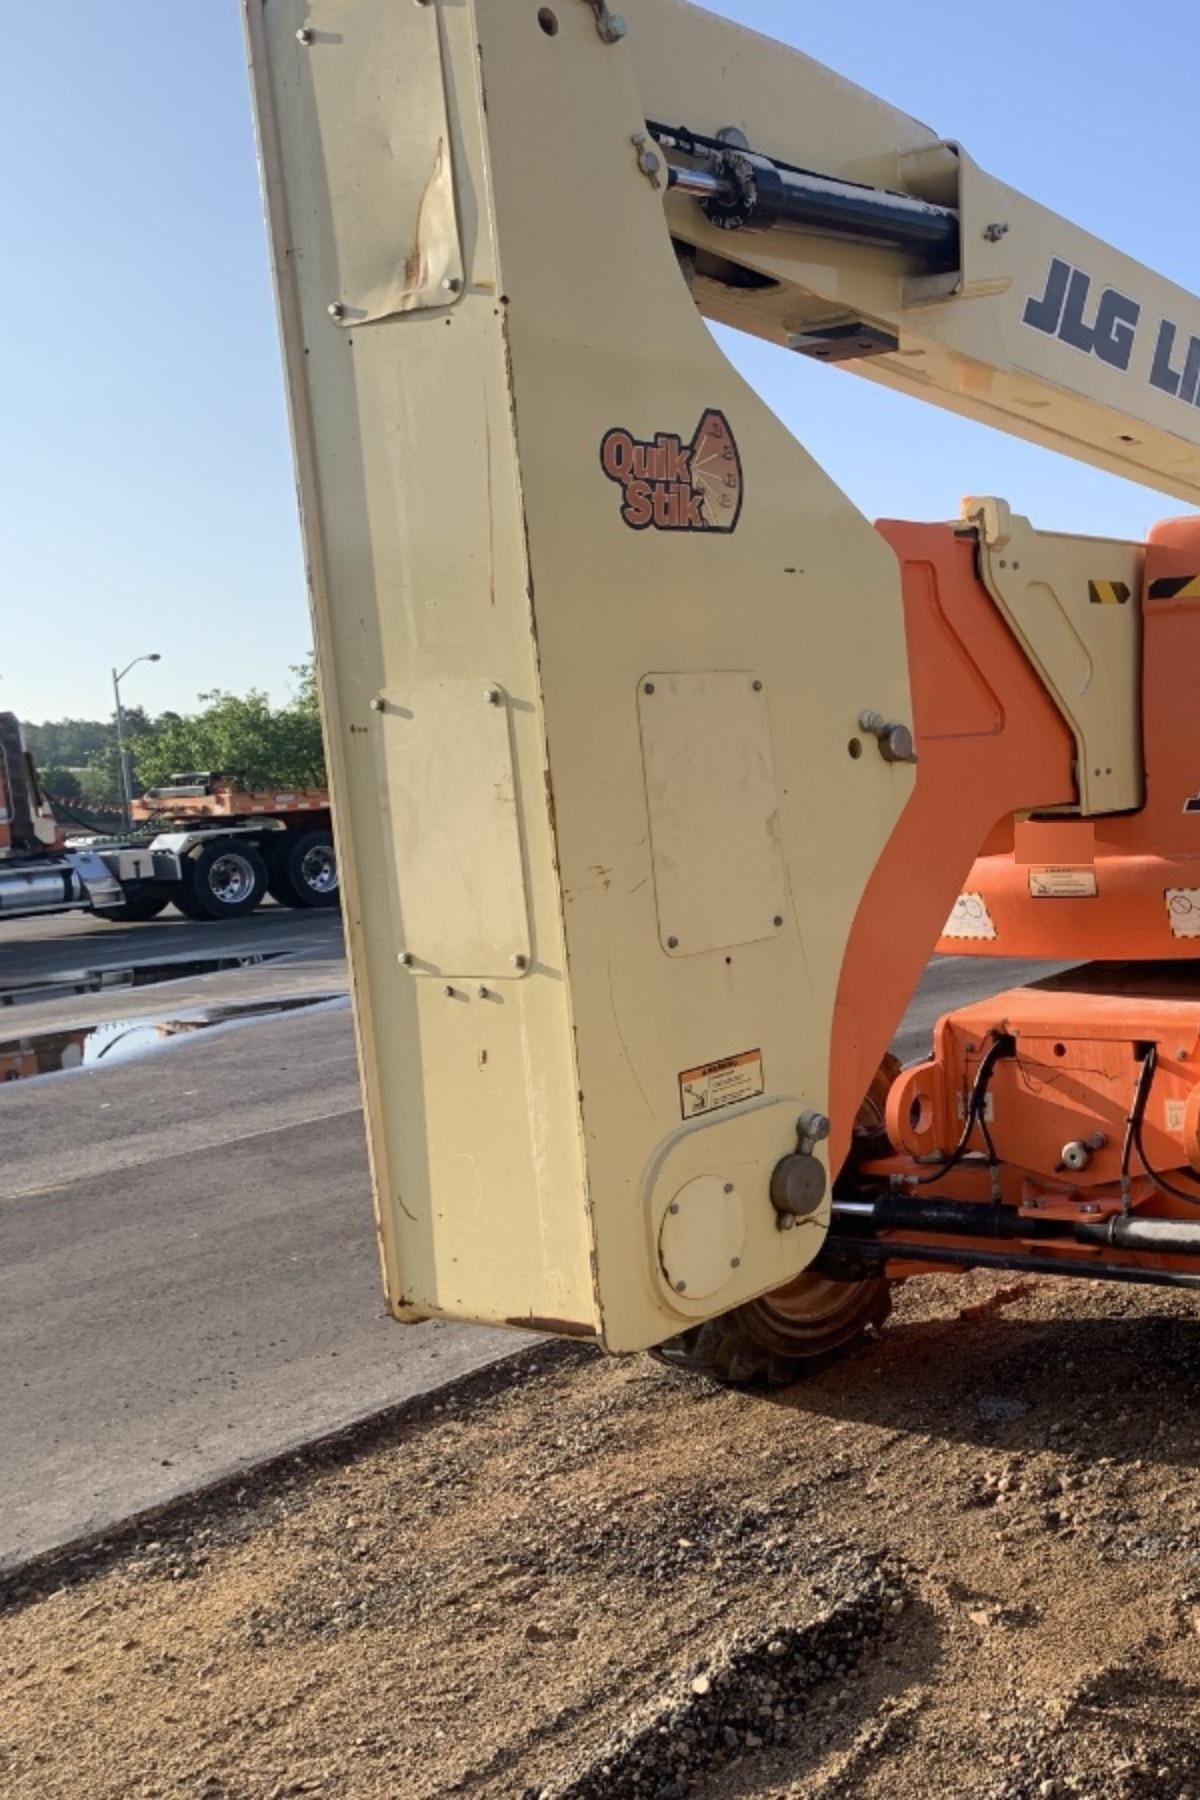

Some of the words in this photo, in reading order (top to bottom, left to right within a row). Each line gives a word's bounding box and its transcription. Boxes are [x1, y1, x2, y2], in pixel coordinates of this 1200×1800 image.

[1021, 256, 1141, 373] JLG
[602, 429, 693, 485] Quik
[622, 479, 704, 528] Stik
